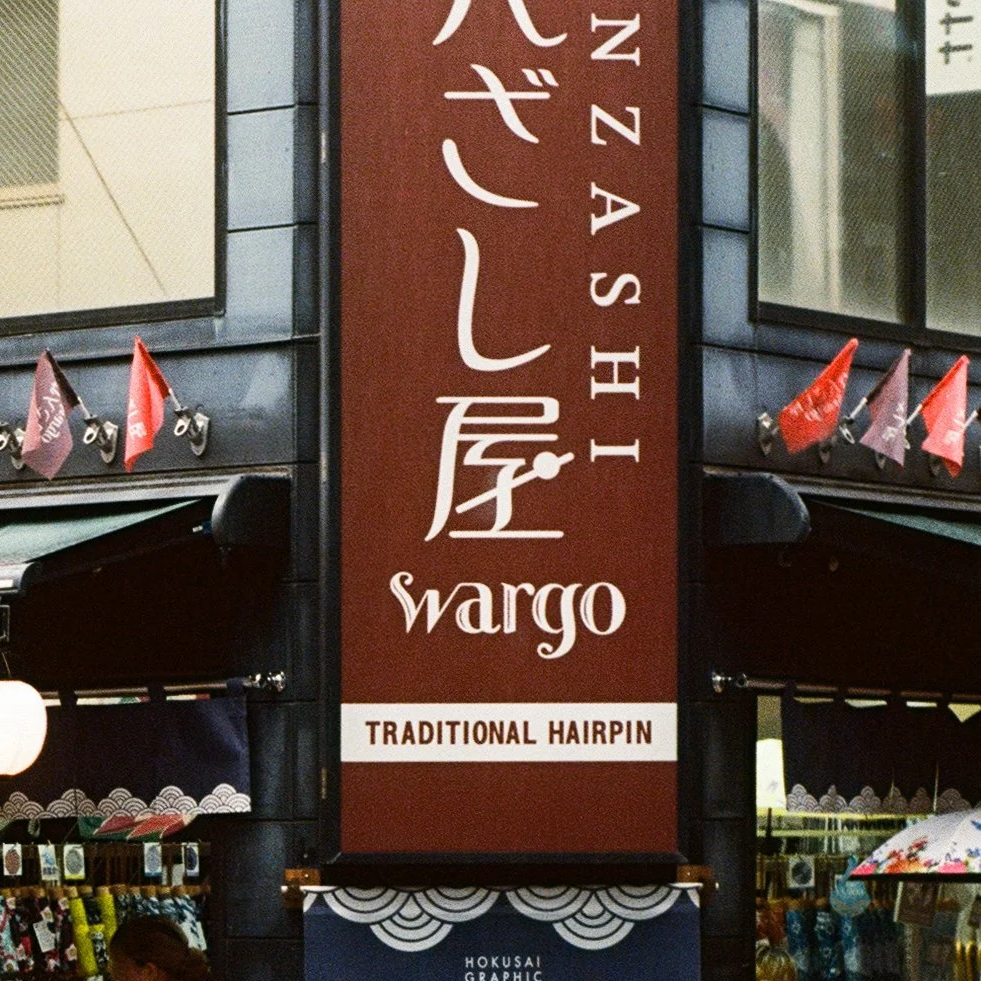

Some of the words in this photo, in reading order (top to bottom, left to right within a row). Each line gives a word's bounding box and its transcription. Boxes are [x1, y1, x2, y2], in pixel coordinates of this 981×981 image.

[390, 571, 626, 659] wargo
[365, 720, 536, 746] TRADITIONAL
[549, 720, 652, 745] HAIRPIN
[465, 956, 540, 969] HOKUSAI
